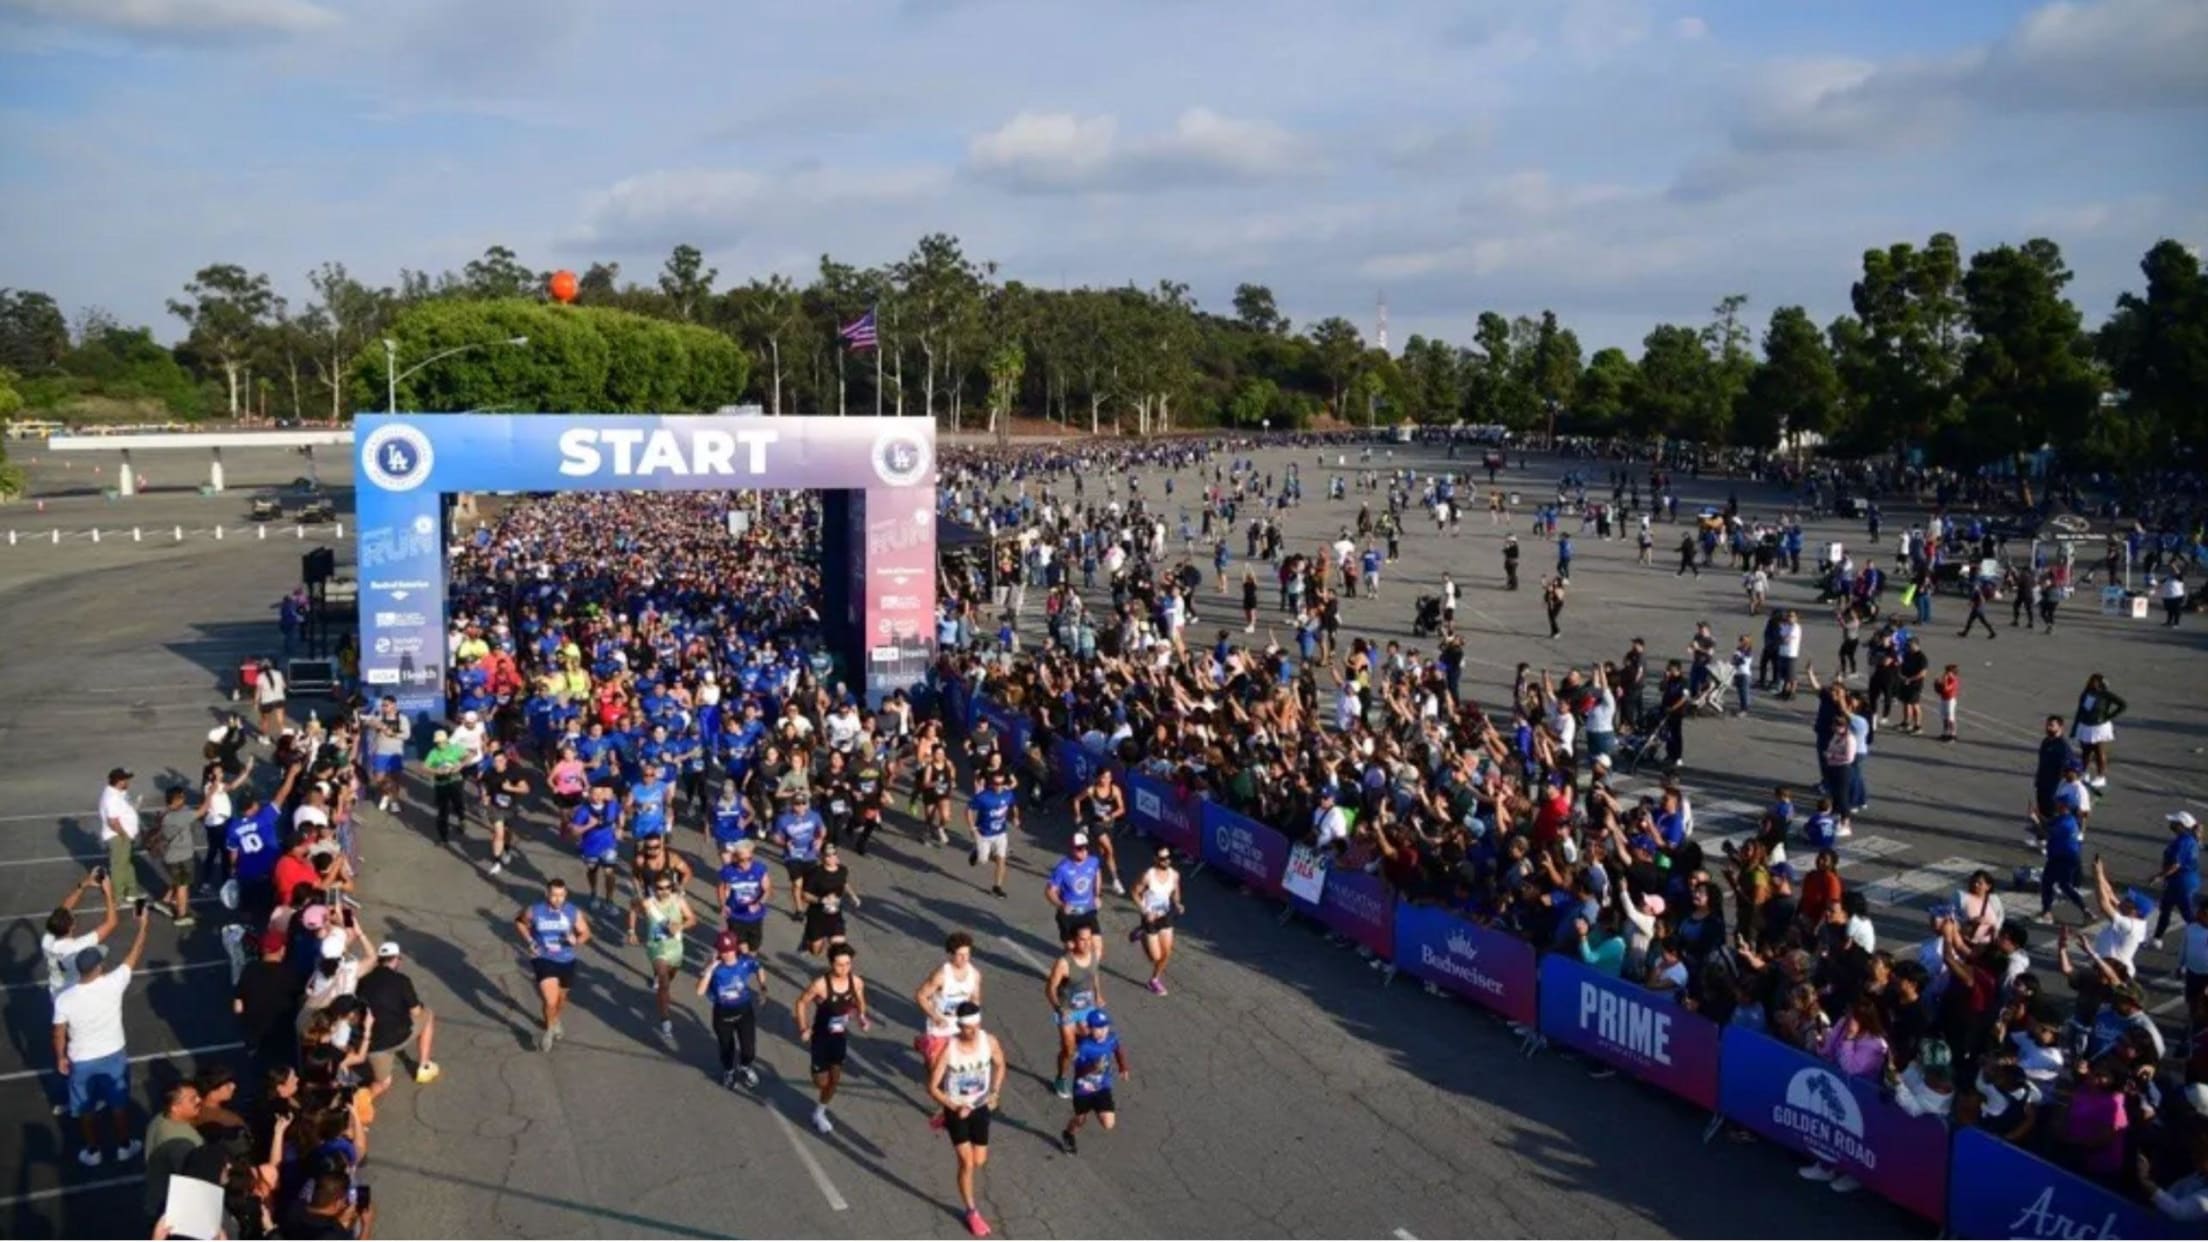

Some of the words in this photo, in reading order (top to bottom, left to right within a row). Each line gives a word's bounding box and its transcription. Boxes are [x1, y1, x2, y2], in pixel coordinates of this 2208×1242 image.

[387, 443, 409, 472] LA
[559, 428, 778, 476] START
[1421, 943, 1505, 996] Budweiser
[1579, 981, 1672, 1066] PRIME
[1773, 1105, 1831, 1142] GOLDEN
[1834, 1129, 1877, 1169] ROAD
